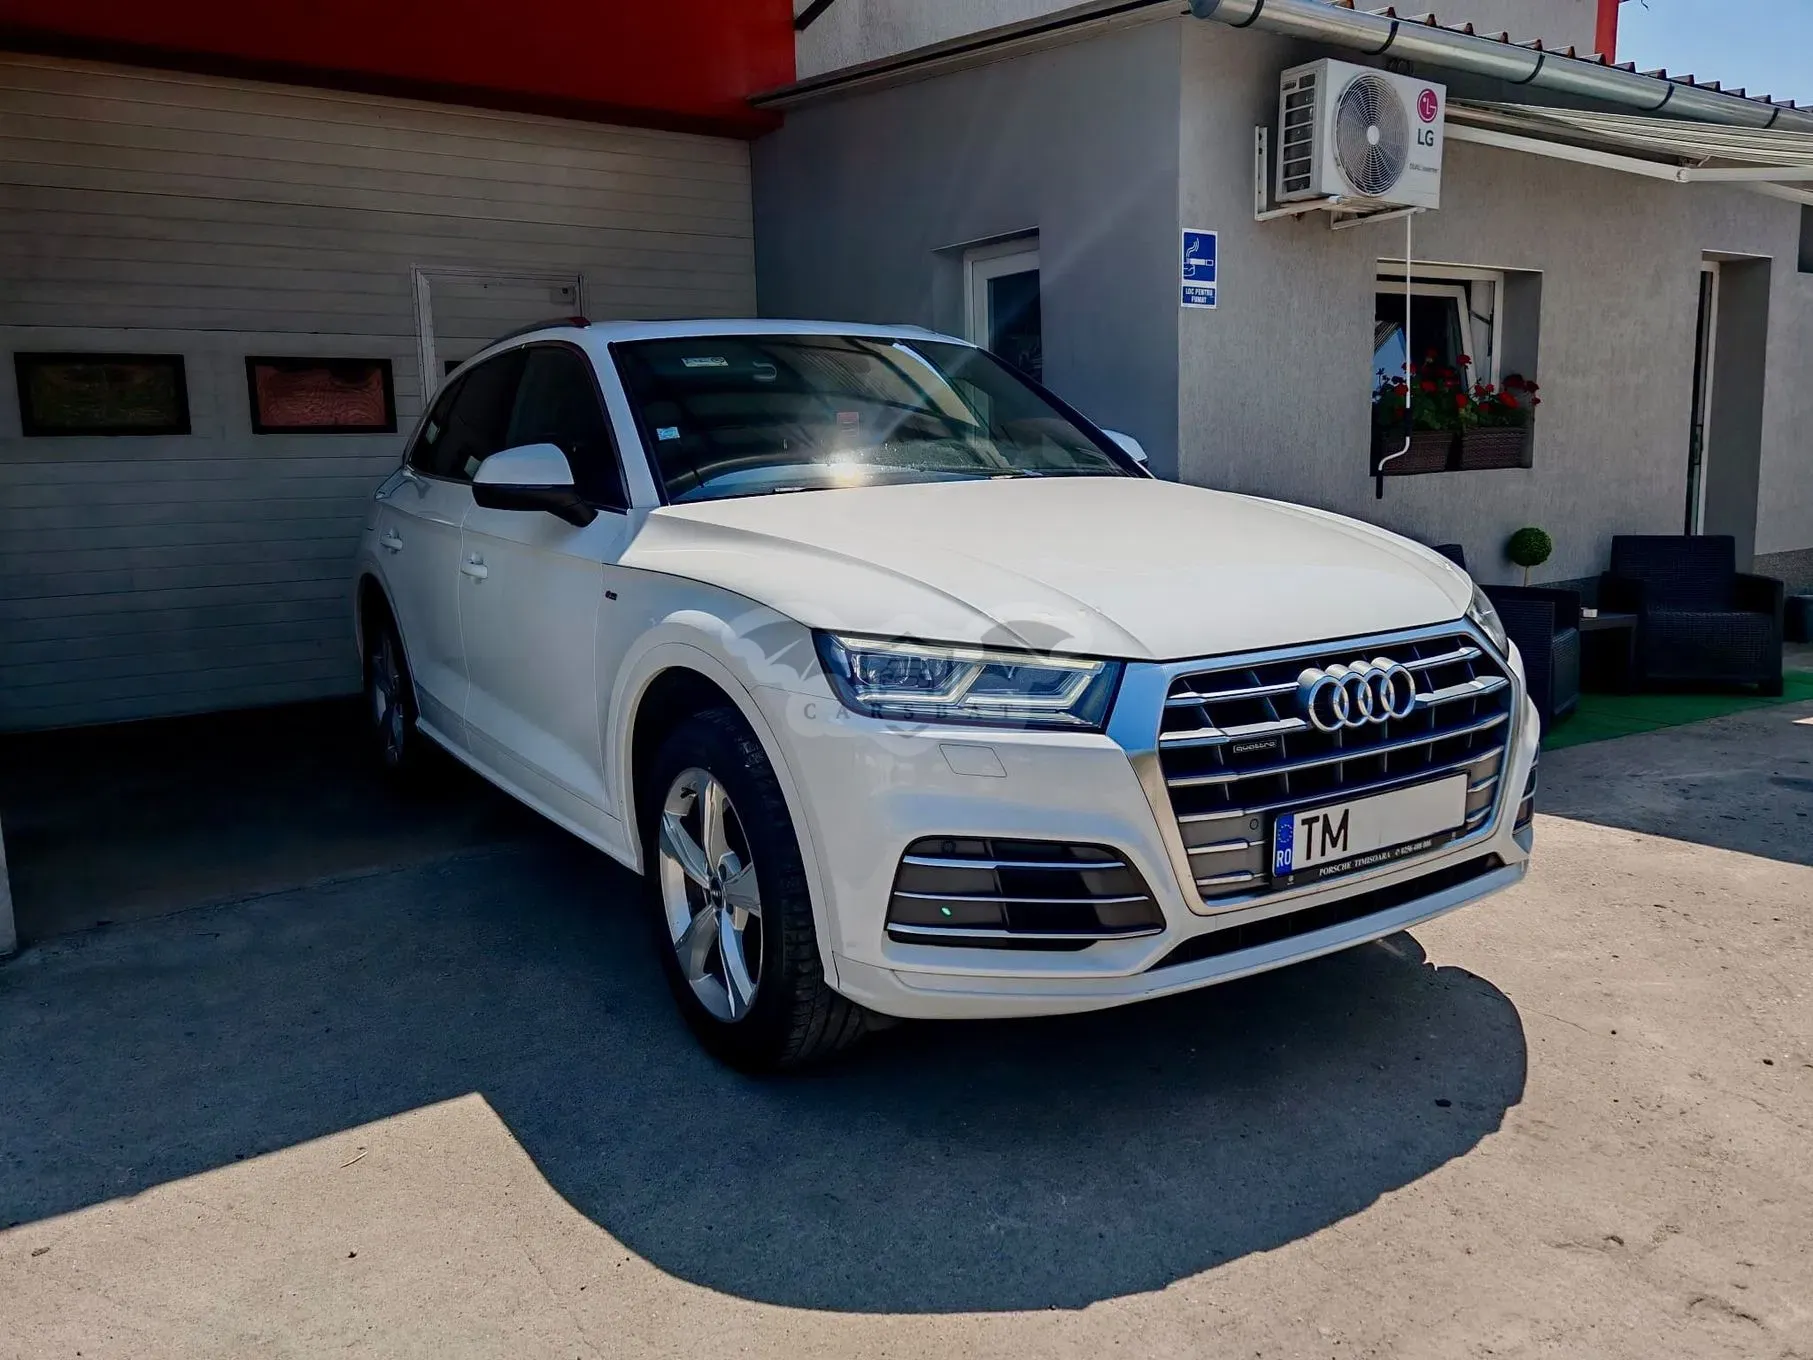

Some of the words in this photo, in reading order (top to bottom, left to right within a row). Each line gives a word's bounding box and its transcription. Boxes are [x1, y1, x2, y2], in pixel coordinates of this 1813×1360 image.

[1417, 128, 1434, 147] LG
[1185, 287, 1194, 295] LOC
[1235, 741, 1276, 752] quattro
[1301, 808, 1350, 861] TM
[1276, 848, 1292, 868] RO
[1319, 860, 1352, 877] PORSCHE
[1354, 851, 1391, 868] TIMISOARA
